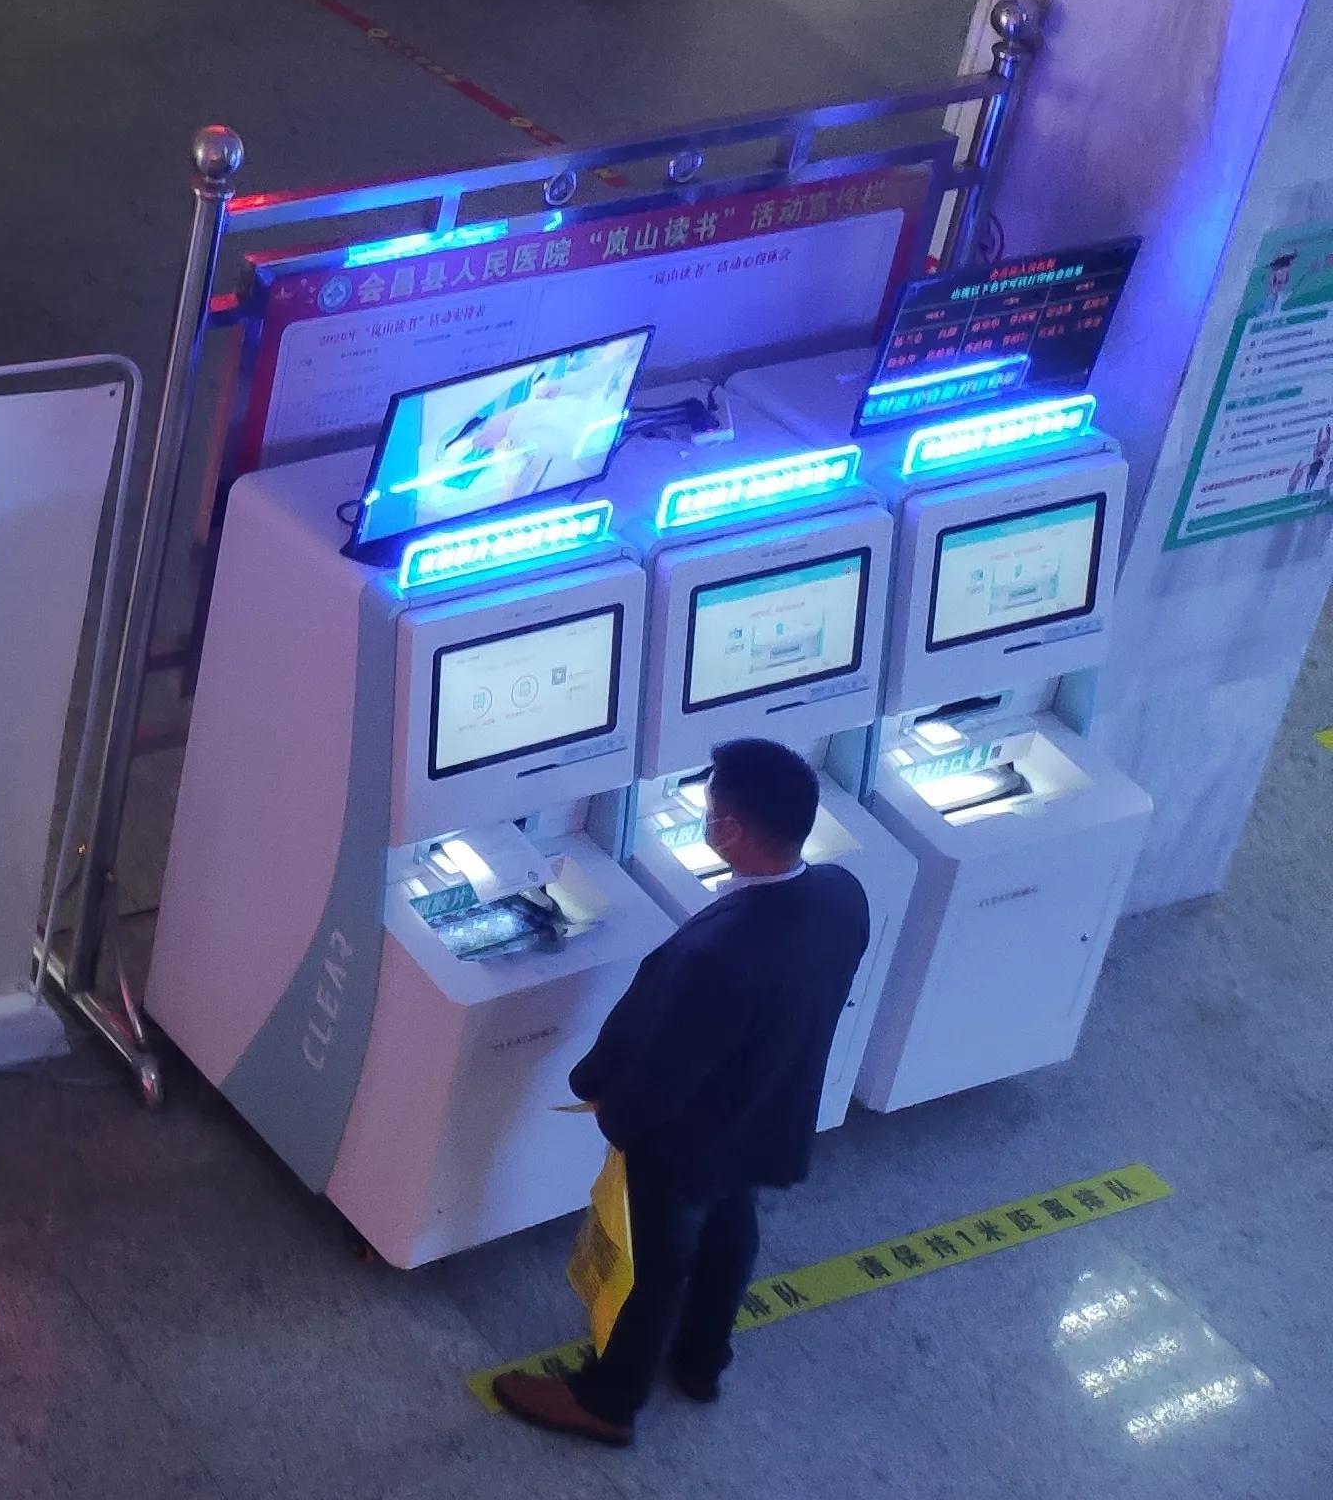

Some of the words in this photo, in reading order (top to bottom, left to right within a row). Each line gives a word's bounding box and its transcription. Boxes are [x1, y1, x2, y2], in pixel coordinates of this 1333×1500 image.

[854, 1178, 1140, 1281] 请保持1米距离排队
